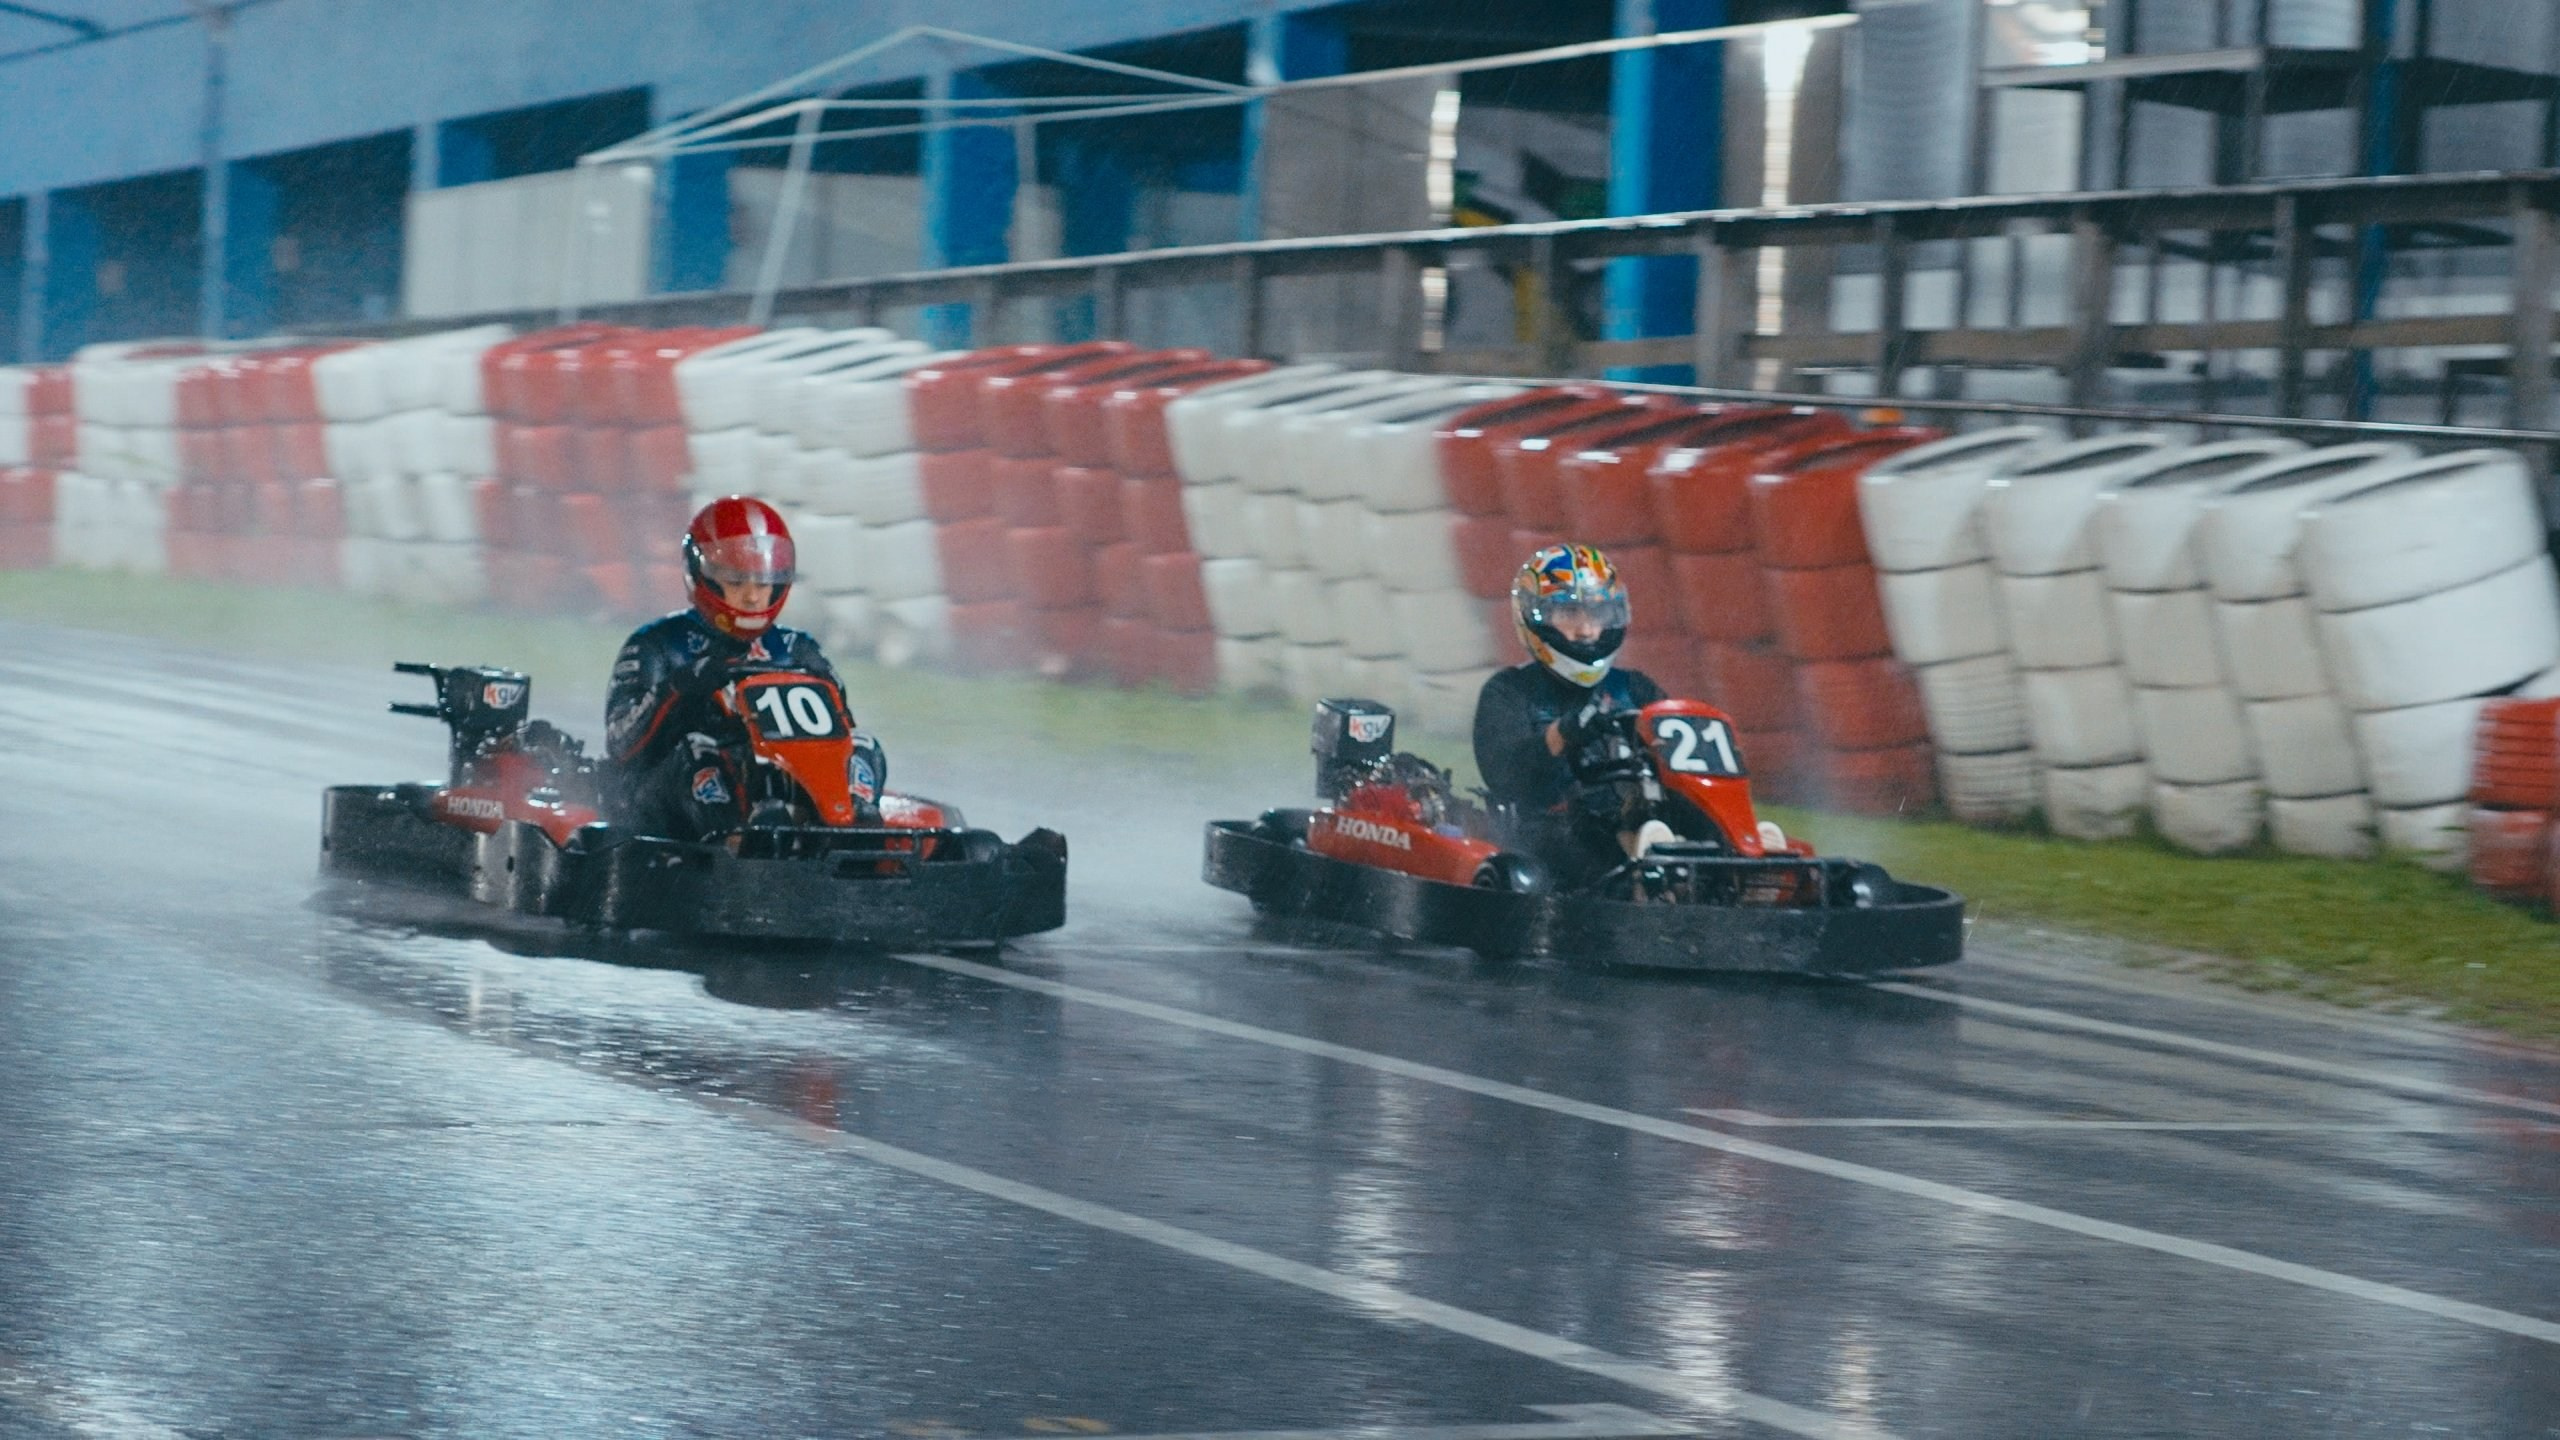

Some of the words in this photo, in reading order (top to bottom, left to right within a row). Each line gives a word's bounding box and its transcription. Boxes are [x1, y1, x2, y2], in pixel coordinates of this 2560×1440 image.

[755, 687, 833, 737] 10
[1658, 718, 1739, 774] 21
[447, 796, 504, 821] HONDA
[1336, 815, 1412, 851] HONDA
